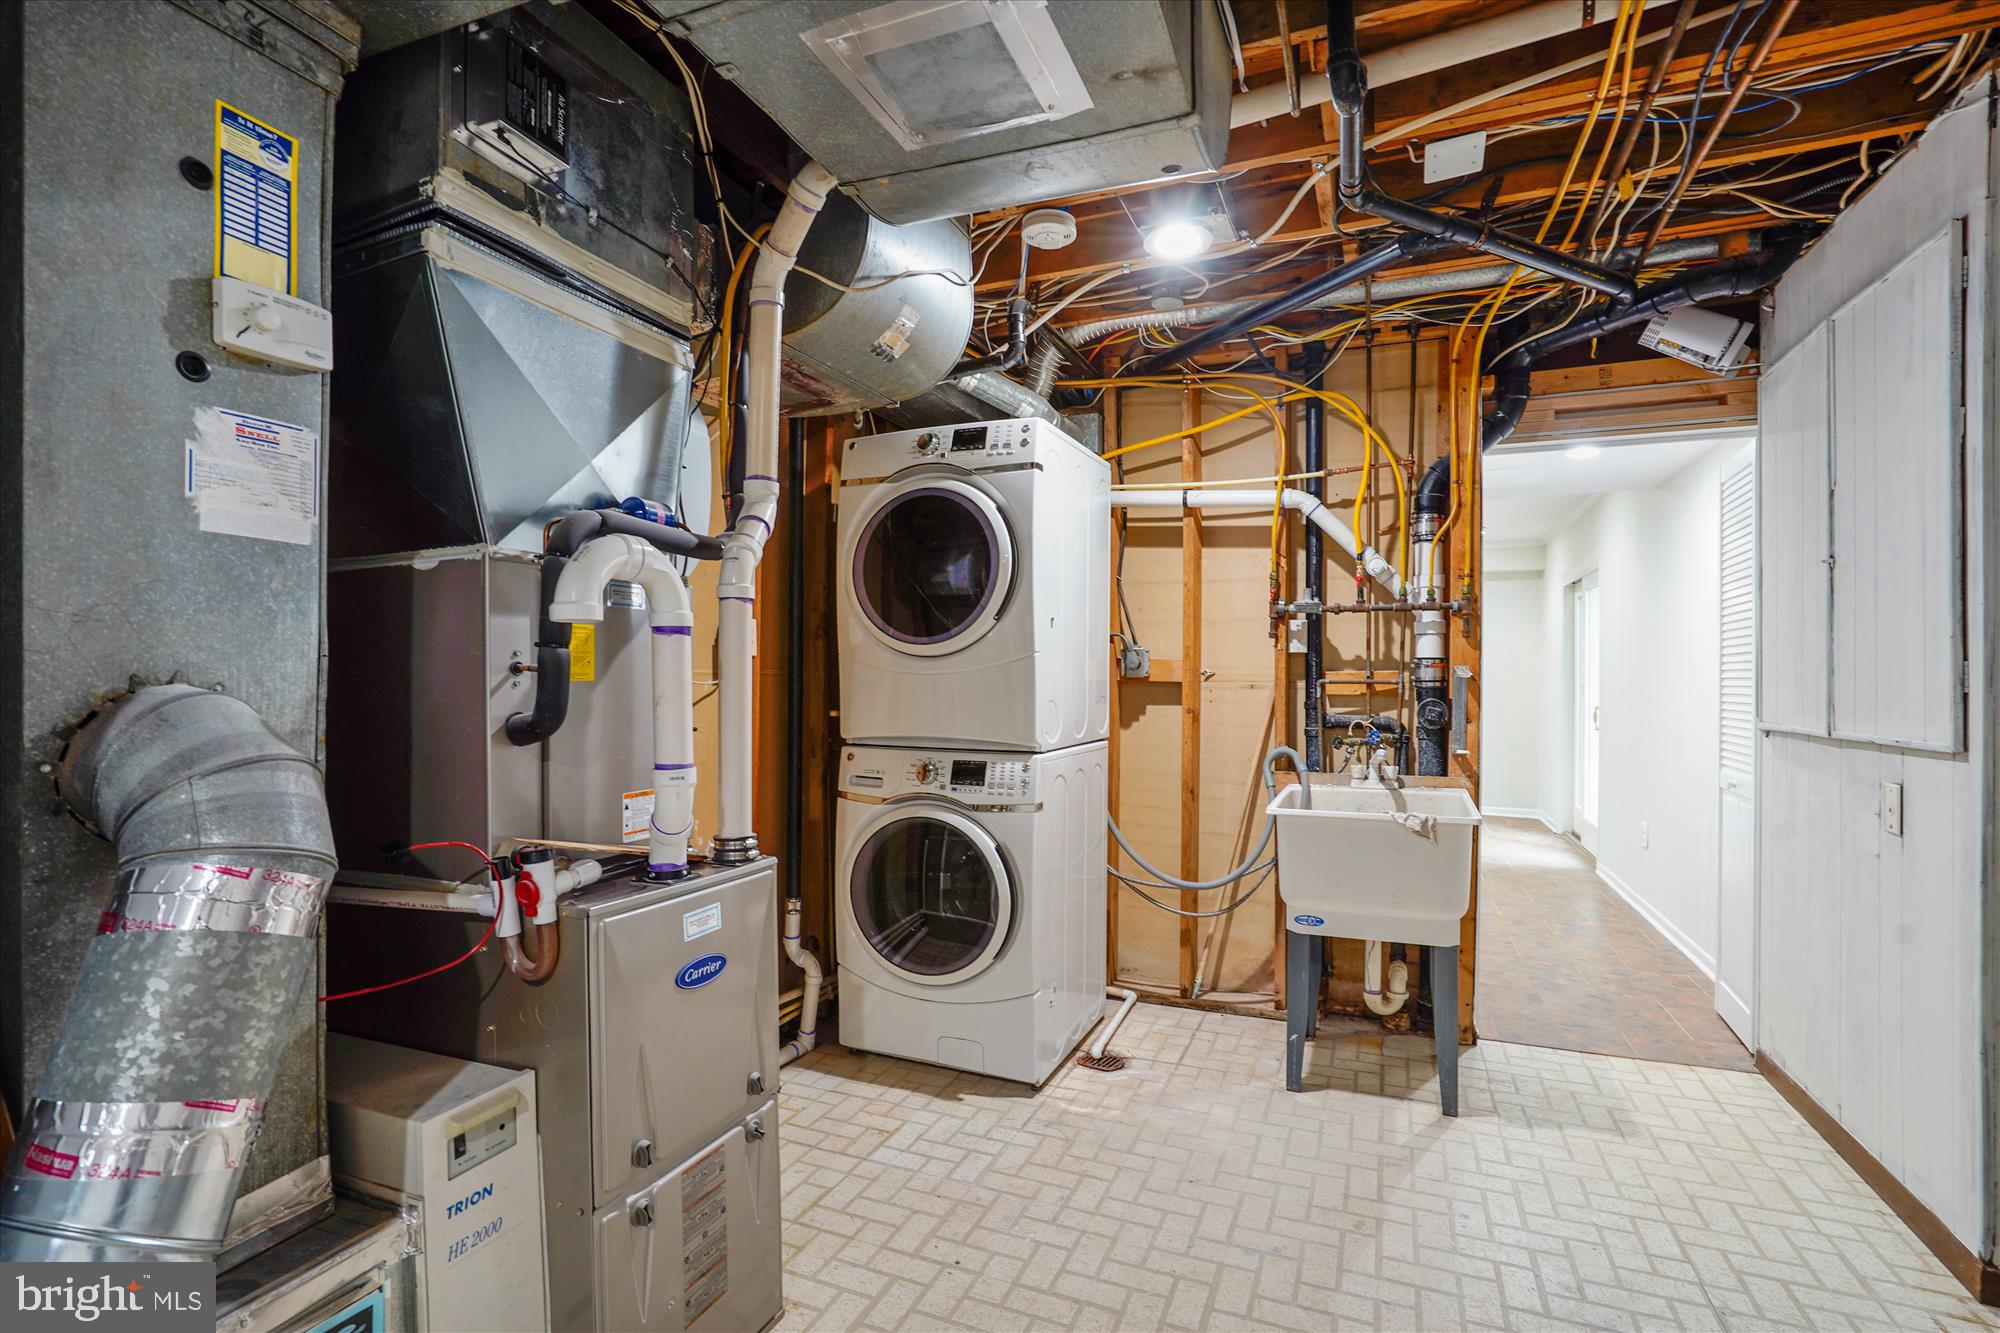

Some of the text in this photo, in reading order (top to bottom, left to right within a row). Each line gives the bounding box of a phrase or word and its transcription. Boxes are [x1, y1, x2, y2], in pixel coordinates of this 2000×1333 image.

[558, 107, 566, 146] Scrubber
[235, 426, 280, 442] SNELL
[684, 960, 722, 983] Carrier
[446, 1183, 494, 1220] TRION
[447, 1217, 503, 1263] HE 2000
